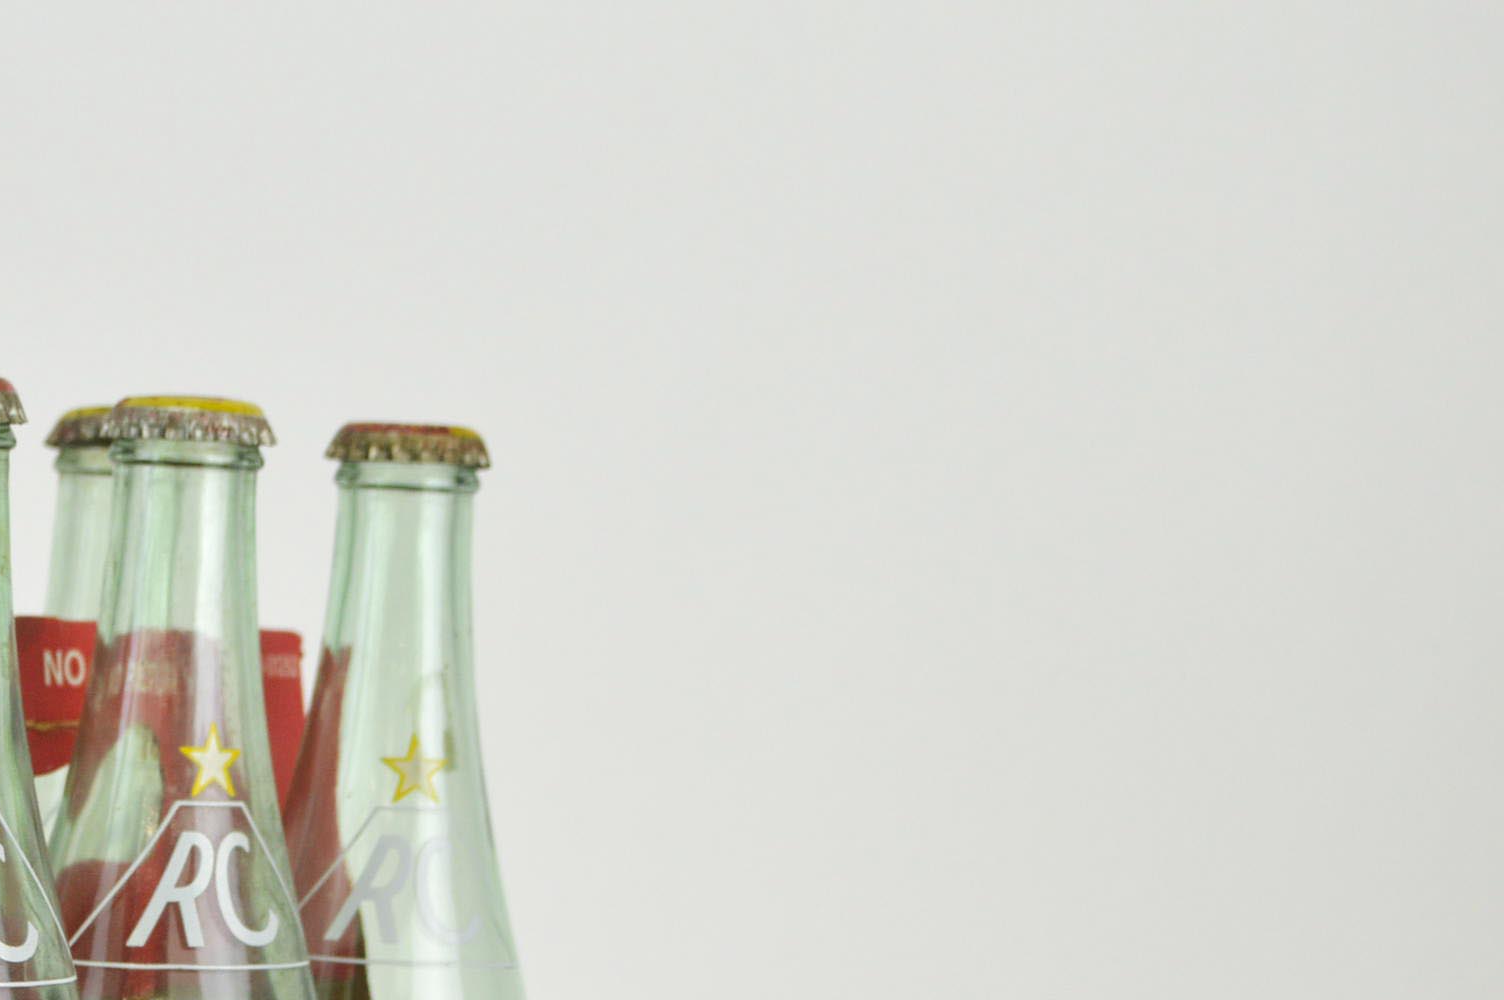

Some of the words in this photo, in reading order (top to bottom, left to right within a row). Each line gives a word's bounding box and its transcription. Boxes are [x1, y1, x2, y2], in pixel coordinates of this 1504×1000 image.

[43, 648, 86, 687] NO
[126, 831, 279, 948] RC
[323, 833, 482, 945] RC
